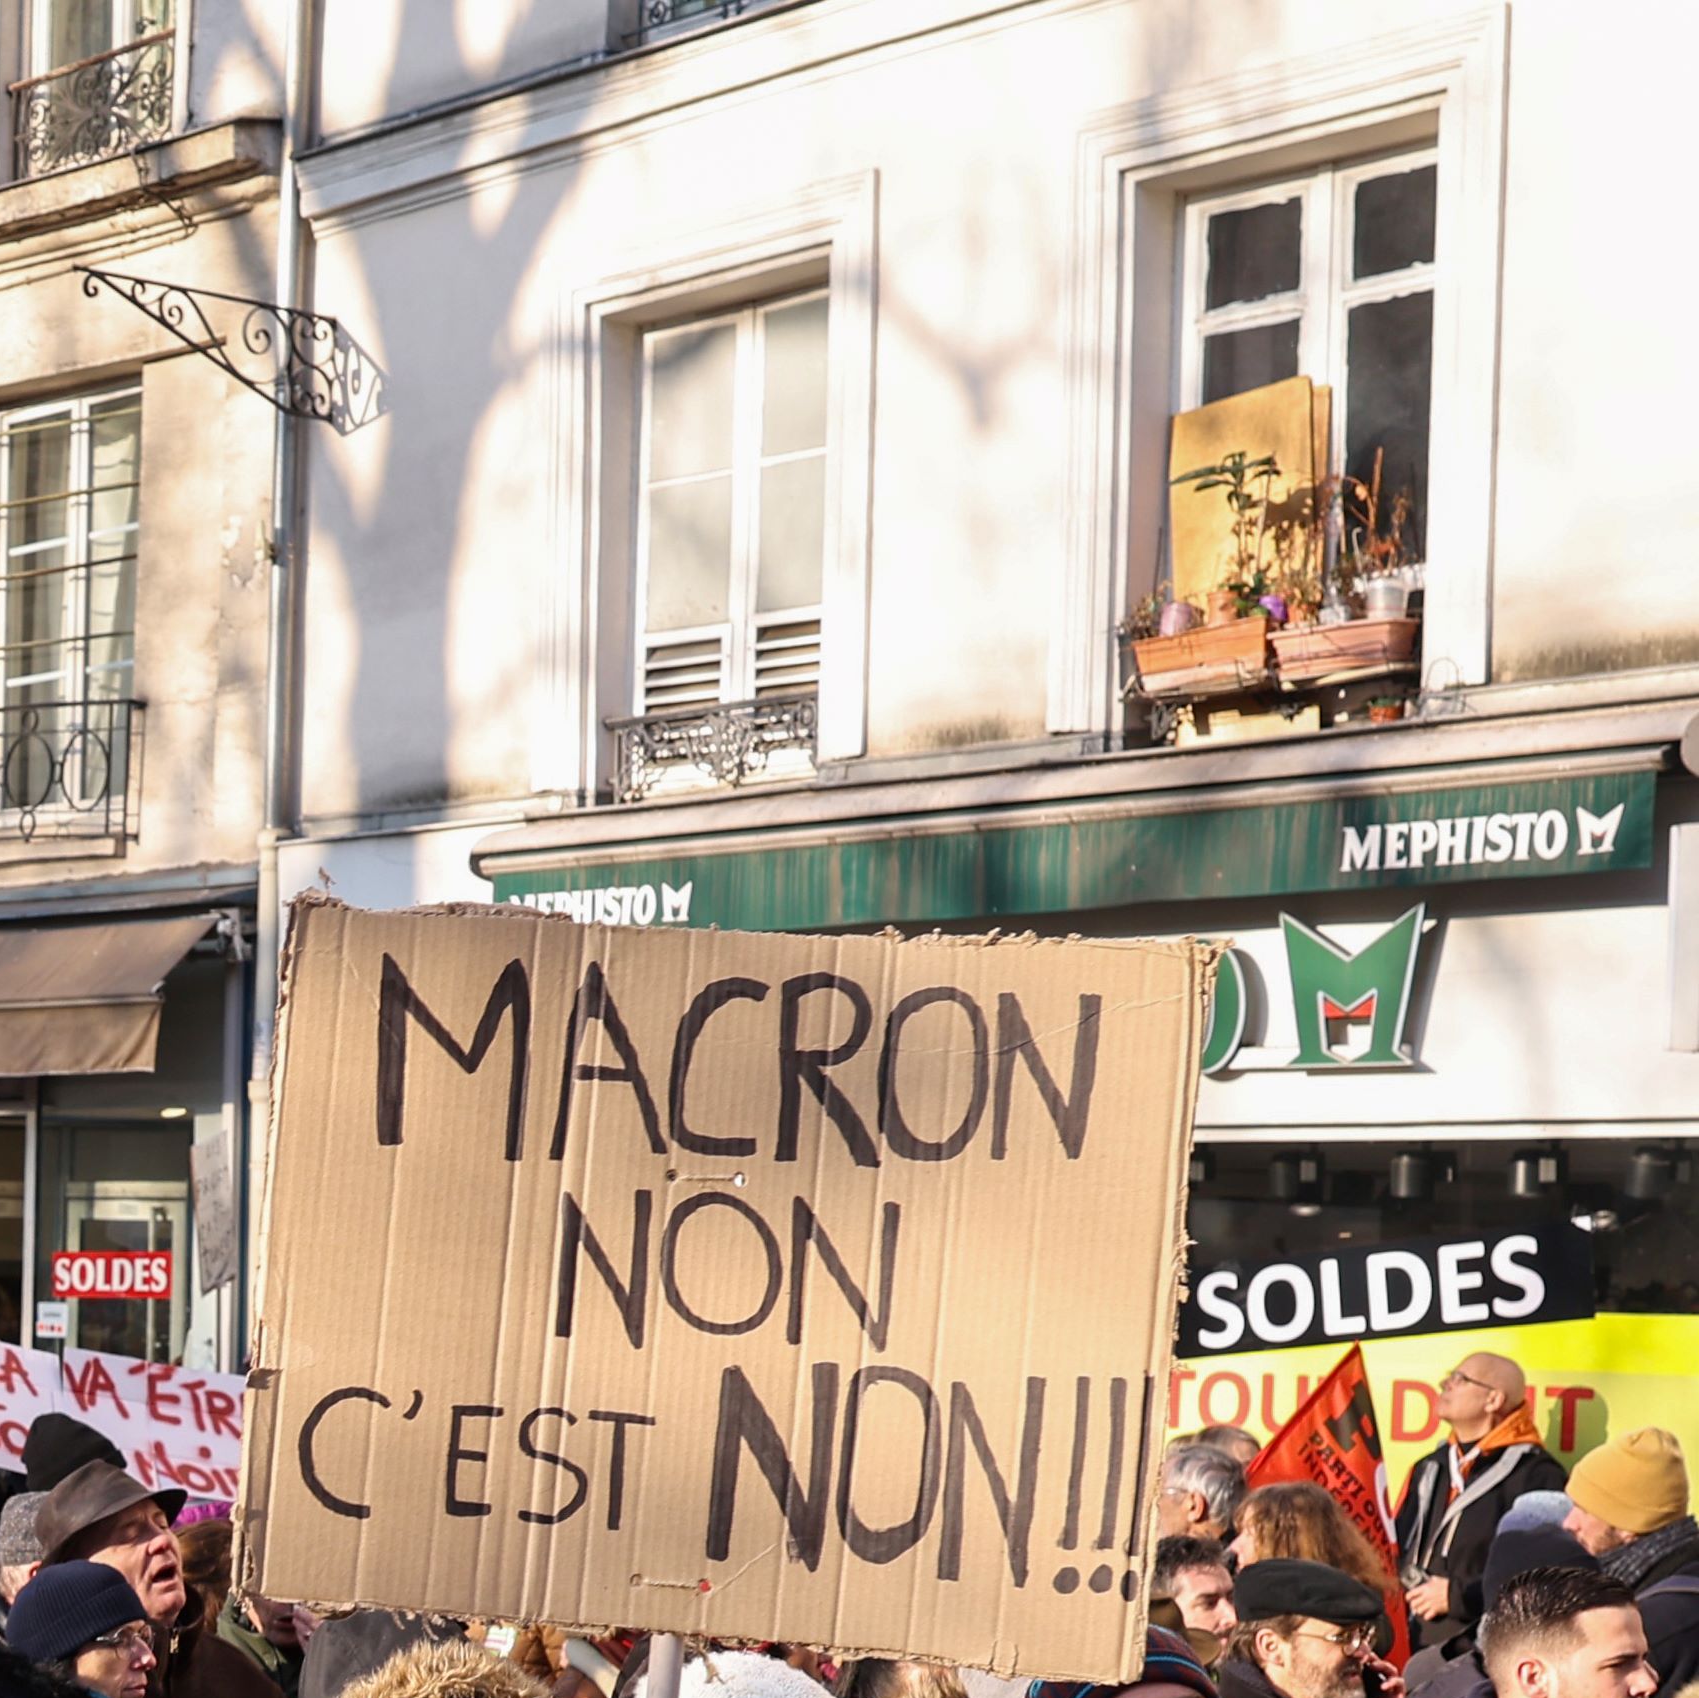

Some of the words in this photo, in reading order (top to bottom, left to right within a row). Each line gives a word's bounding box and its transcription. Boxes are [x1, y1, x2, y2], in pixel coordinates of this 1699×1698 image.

[1339, 809, 1569, 872] MEPHISTO
[377, 951, 1103, 1168] MACRON
[55, 1257, 167, 1293] SOLDES
[555, 1187, 901, 1353] NON
[1198, 1234, 1546, 1351] SOLDES
[64, 1357, 129, 1419] VA
[129, 1360, 243, 1440] ÊTR
[1168, 1370, 1321, 1428] TOU
[297, 1385, 656, 1531] C'EST
[705, 1361, 1155, 1602] NON!!!
[1309, 1429, 1365, 1499] PARTI
